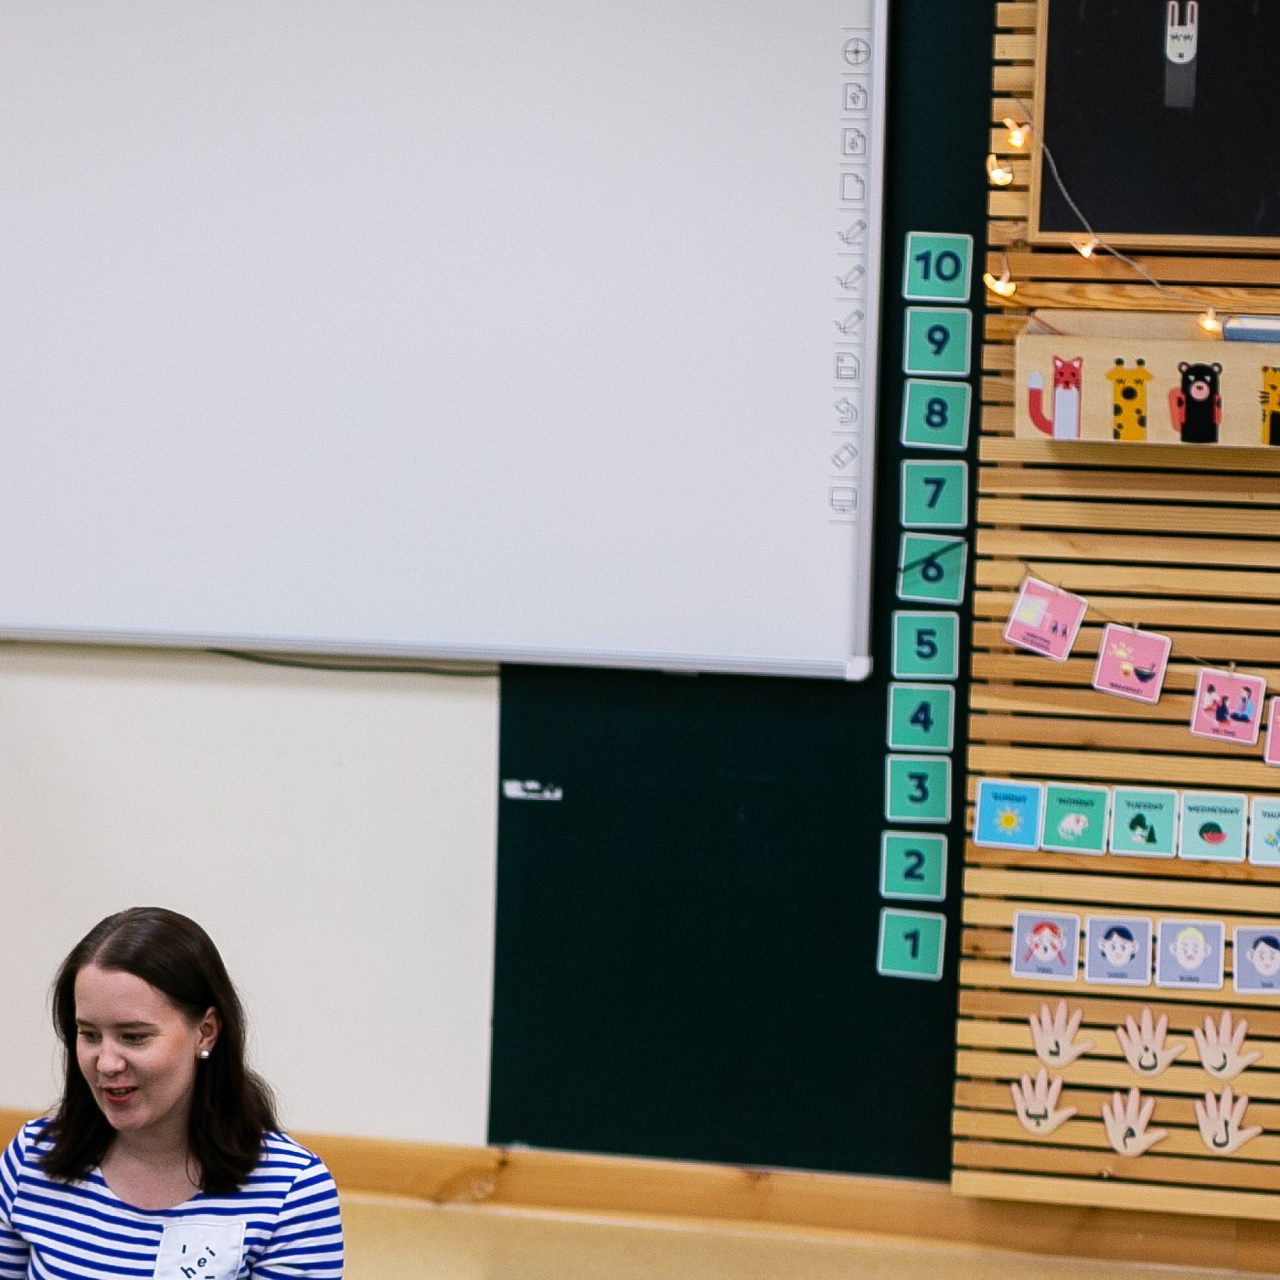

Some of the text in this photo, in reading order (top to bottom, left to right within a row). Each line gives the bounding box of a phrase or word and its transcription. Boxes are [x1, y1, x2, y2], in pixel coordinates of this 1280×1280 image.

[915, 250, 961, 282] 10
[927, 324, 950, 356] 9
[925, 397, 948, 429] 8
[923, 477, 946, 508] 7
[921, 553, 944, 583] 6
[916, 628, 938, 660] 5
[910, 701, 934, 733] 4
[908, 772, 929, 803] 3
[903, 850, 925, 881] 2
[904, 929, 920, 959] 1
[1138, 1046, 1158, 1072] ن
[1025, 1107, 1049, 1127] ب
[1123, 1126, 1136, 1150] م
[1212, 1119, 1230, 1149] ل
